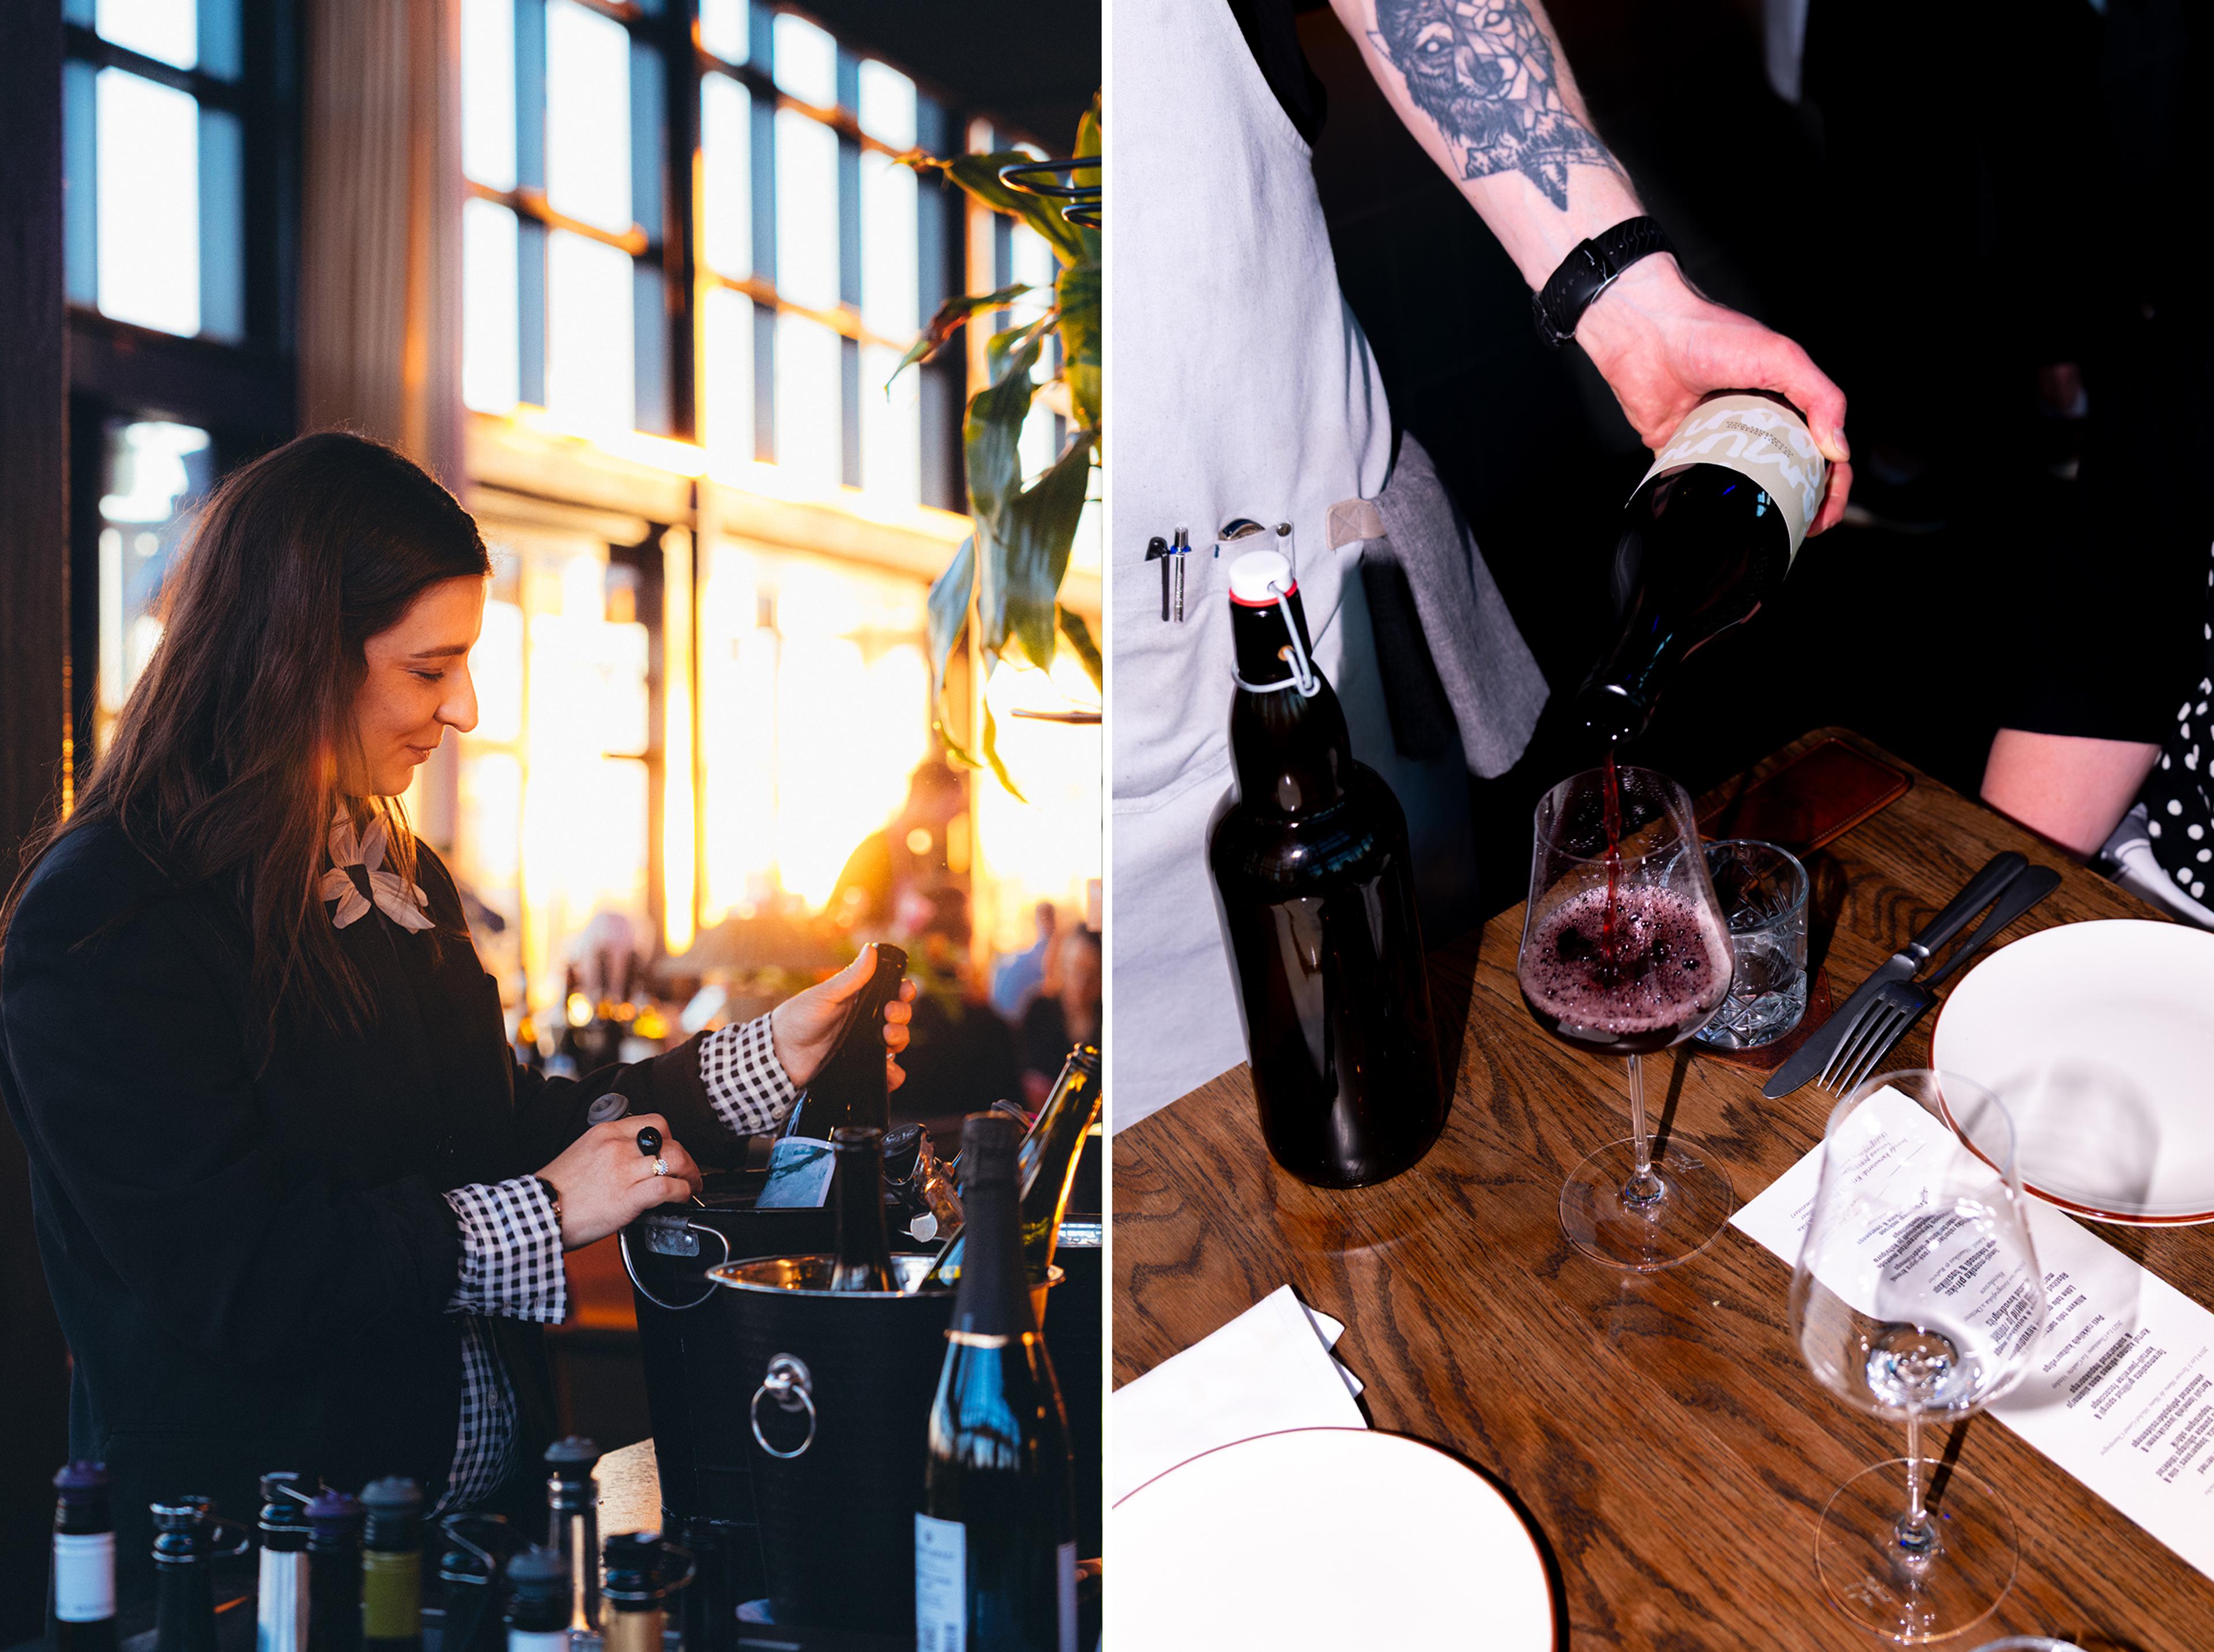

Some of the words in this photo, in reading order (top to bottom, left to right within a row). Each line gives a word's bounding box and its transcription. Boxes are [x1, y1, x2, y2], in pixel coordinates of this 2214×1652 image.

[1957, 1263, 1968, 1273] &
[2045, 1271, 2069, 1292] Röstitud
[2050, 1295, 2065, 1307] talu
[2055, 1310, 2070, 1323] talu
[2091, 1313, 2106, 1326] Peti
[2070, 1322, 2096, 1346] rukkileib
[2123, 1332, 2133, 1340] &
[2132, 1327, 2151, 1344] Kartul
[2041, 1341, 2076, 1374] kultuurvõiga
[2098, 1336, 2128, 1365] suitsutatud
[2116, 1341, 2137, 1360] kolmes
[2098, 1356, 2121, 1376] võtmes
[2067, 1361, 2102, 1394] hapukoorega
[2087, 1374, 2103, 1388] koos
[2177, 1372, 2206, 1400] vinnutatud
[2113, 1376, 2137, 1400] grillitud
[2193, 1379, 2213, 1398] Kartuli
[2093, 1412, 2102, 1420] &
[2173, 1395, 2198, 1419] lameleib
[2144, 1415, 2179, 1449] juustukreemi
[2140, 1446, 2149, 1454] &
